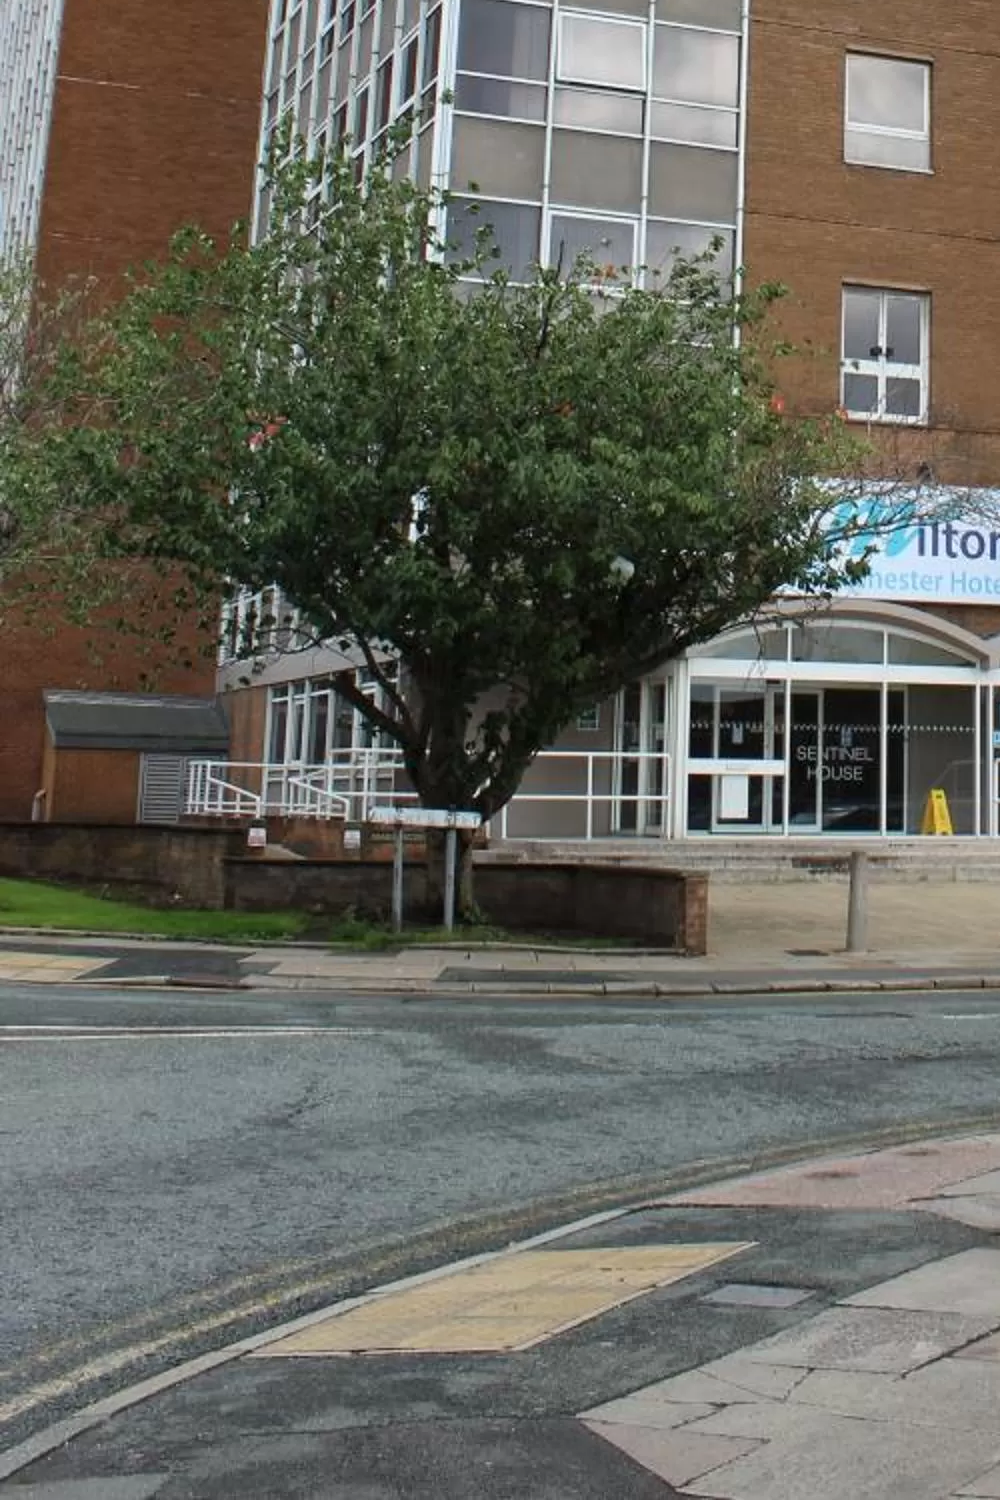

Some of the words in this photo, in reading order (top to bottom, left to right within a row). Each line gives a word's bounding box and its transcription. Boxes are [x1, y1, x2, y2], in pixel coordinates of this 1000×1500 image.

[856, 567, 942, 592] hester
[796, 745, 874, 761] SENTINEL
[807, 765, 864, 781] HOUSE
